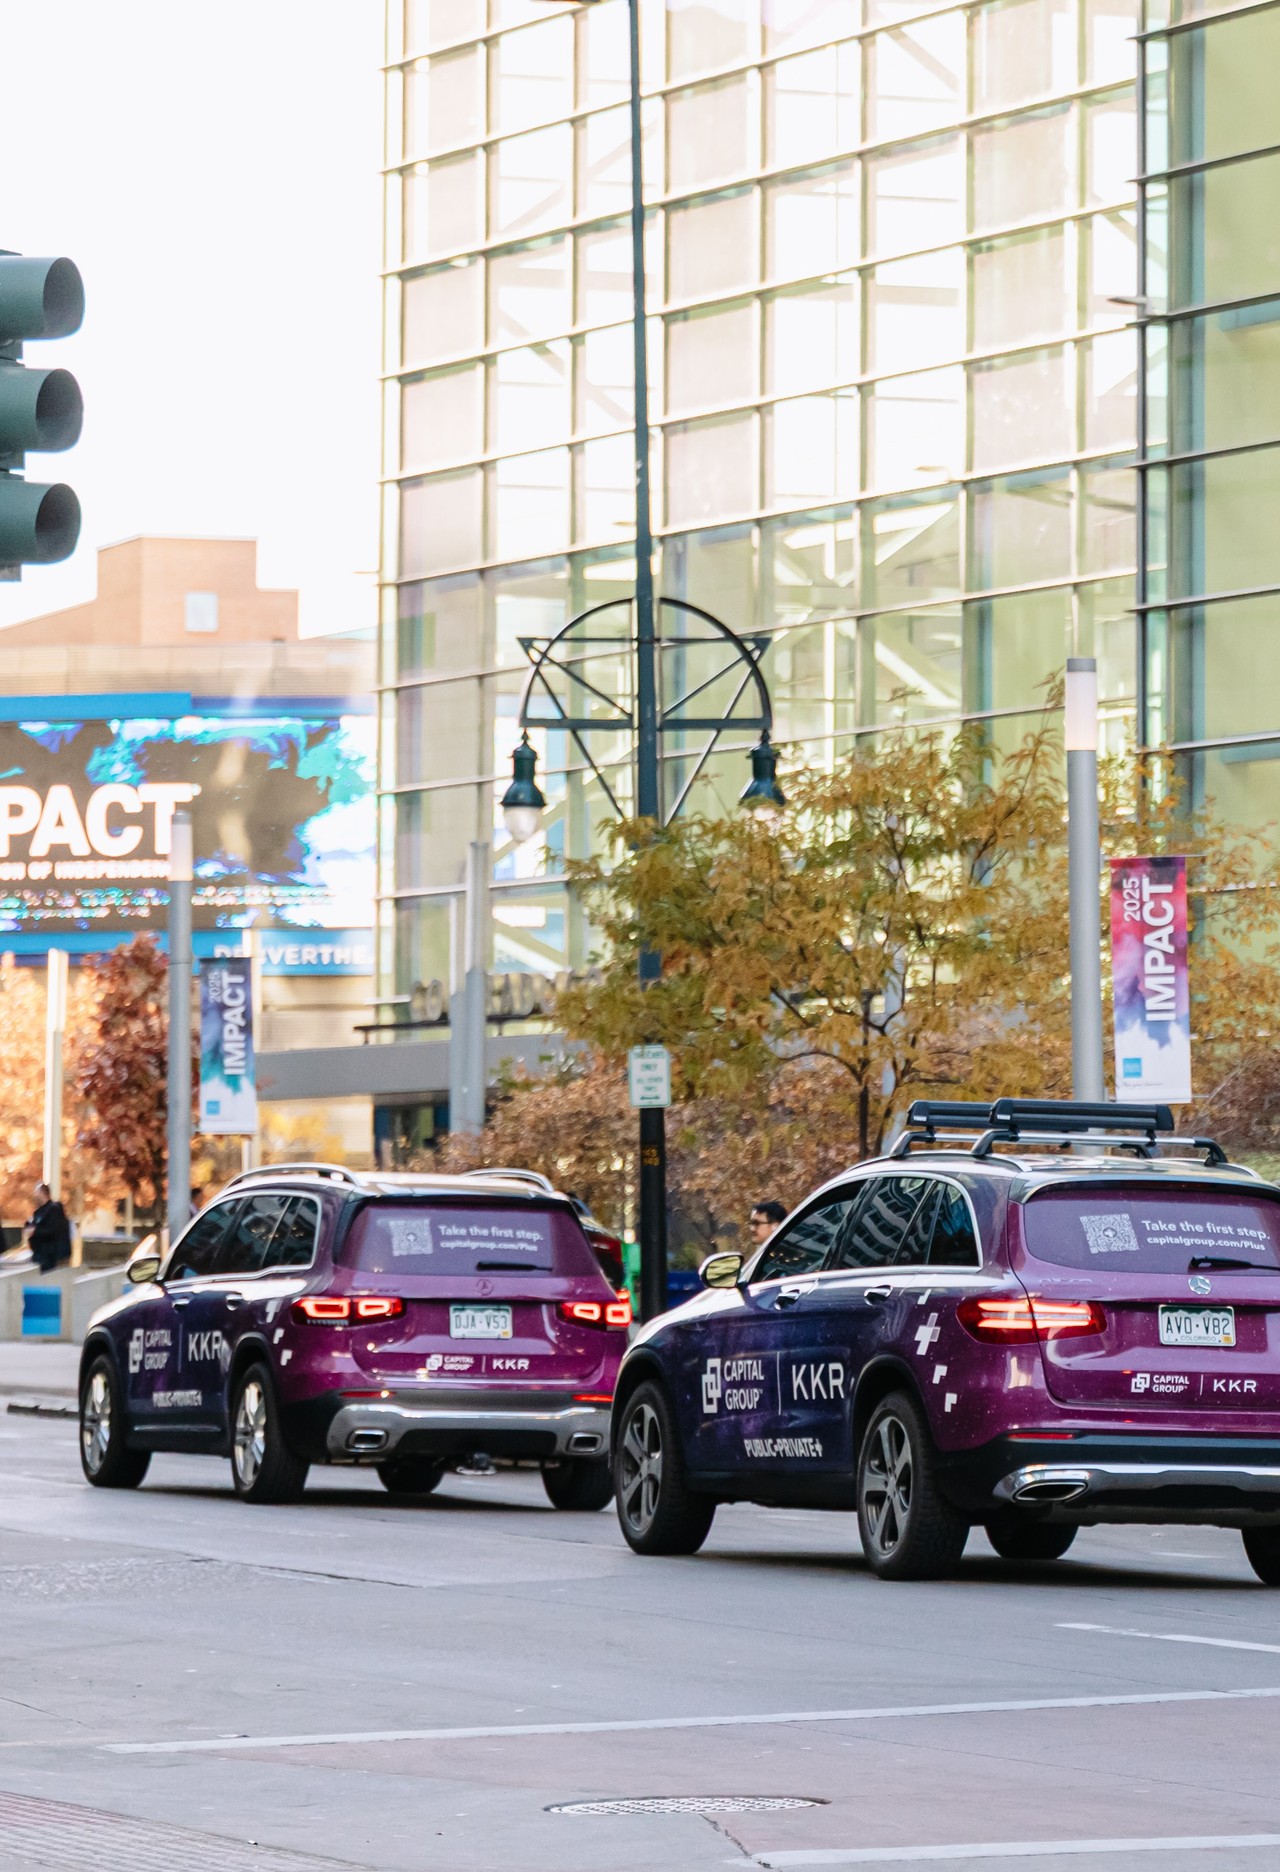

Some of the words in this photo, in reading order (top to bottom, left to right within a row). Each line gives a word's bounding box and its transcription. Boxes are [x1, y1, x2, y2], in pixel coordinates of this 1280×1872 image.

[1123, 877, 1141, 922] 2025
[1142, 874, 1177, 1022] IMPACT
[208, 970, 222, 1004] 2025
[222, 970, 246, 1076] IMPACT
[439, 1225, 467, 1237] Take
[469, 1226, 490, 1237] the
[491, 1226, 515, 1239] first
[516, 1229, 544, 1242] step.
[1141, 1220, 1177, 1232] Take
[1179, 1220, 1204, 1233] the
[1206, 1222, 1235, 1236] first
[1237, 1226, 1271, 1241] step.
[1147, 1235, 1266, 1251] capitalgroup.com/Plus
[145, 1329, 172, 1348] CAPITAL
[188, 1330, 222, 1362] KKR
[443, 1356, 474, 1365] CAPITAL
[492, 1358, 530, 1371] KKR
[723, 1359, 765, 1382] CAPITAL
[792, 1362, 845, 1401] KKR
[1153, 1375, 1190, 1385] CAPITAL
[1213, 1379, 1257, 1393] KKR
